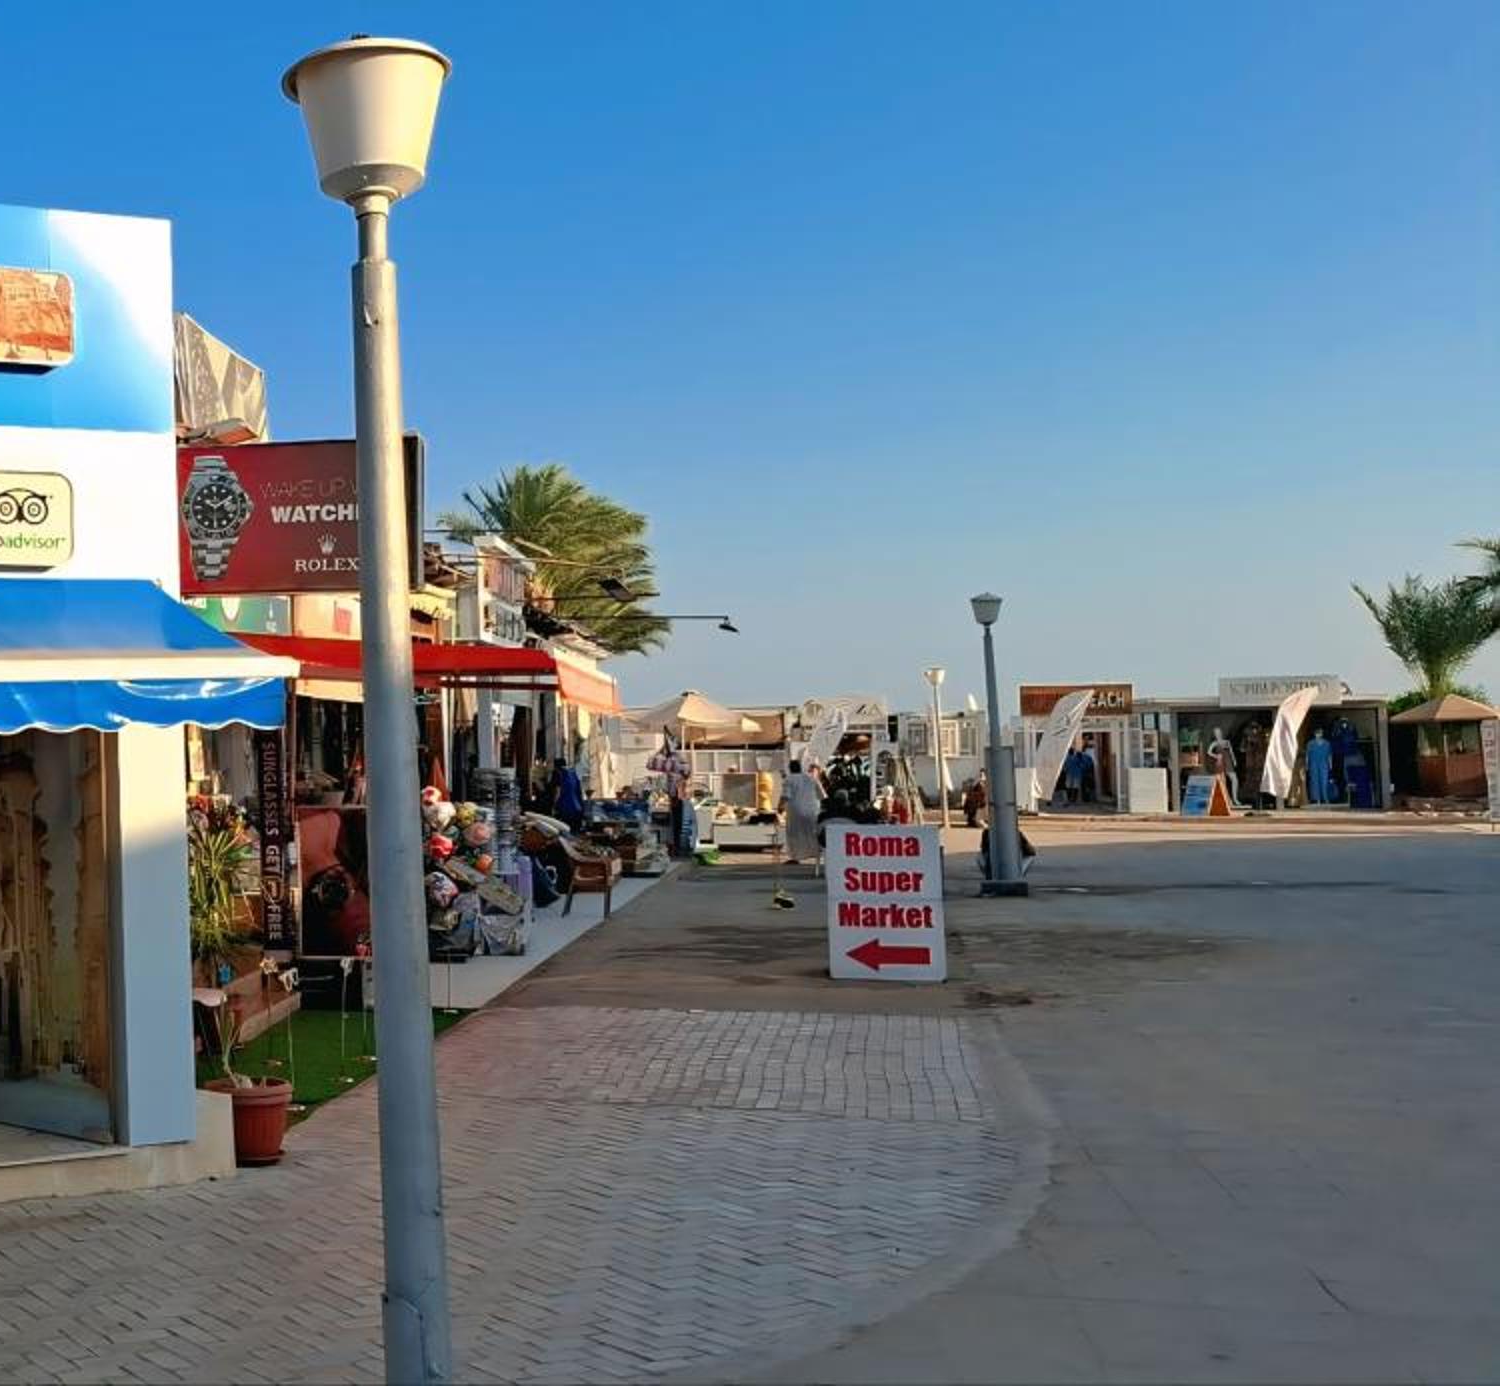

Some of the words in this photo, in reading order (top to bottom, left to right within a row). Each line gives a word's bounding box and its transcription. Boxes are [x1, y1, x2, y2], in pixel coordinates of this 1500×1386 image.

[260, 479, 314, 498] WAKE
[319, 477, 346, 497] UP
[270, 503, 359, 524] WATCH
[293, 557, 361, 573] ROLEX
[1091, 690, 1125, 708] EACH
[263, 741, 279, 837] SUNGLASSES
[845, 832, 921, 857] Roma
[265, 845, 281, 875] GET
[844, 867, 923, 894] Super
[267, 905, 282, 941] FREE
[838, 902, 934, 929] Market
